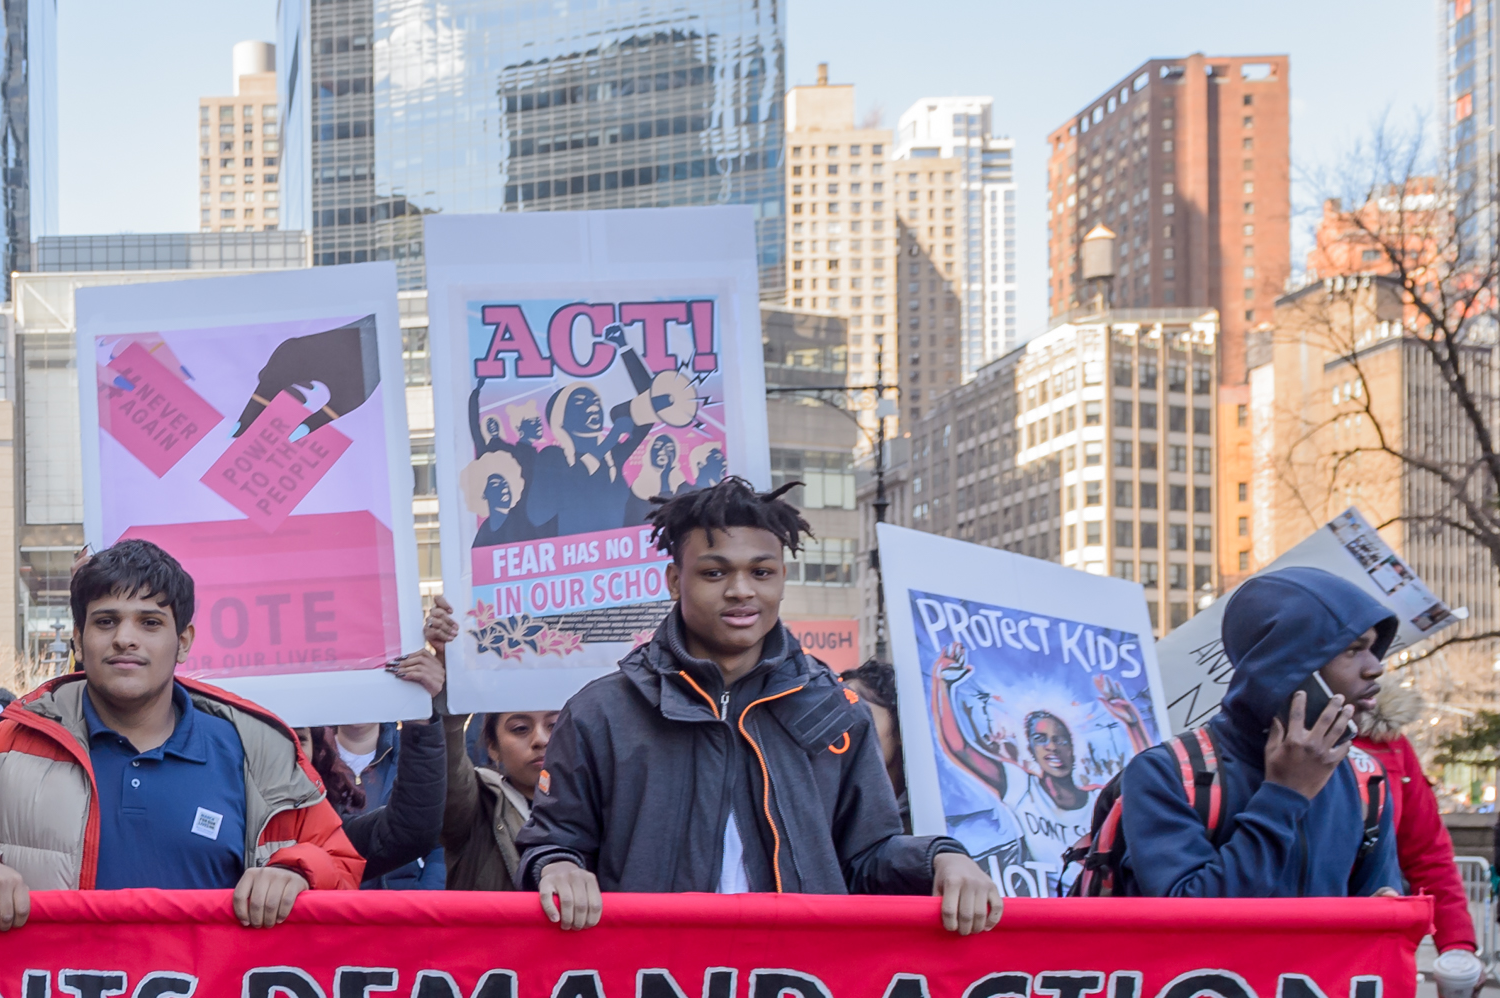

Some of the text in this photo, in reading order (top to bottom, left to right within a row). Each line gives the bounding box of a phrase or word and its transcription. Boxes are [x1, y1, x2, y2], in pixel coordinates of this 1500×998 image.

[474, 299, 718, 378] ACT!
[119, 399, 179, 451] AGAIN
[221, 416, 291, 486] POWER
[238, 470, 270, 498] TO
[255, 440, 331, 517] PEOPLE
[492, 542, 557, 579] FEAR
[562, 540, 600, 567] HAS
[605, 535, 634, 561] NO
[495, 566, 669, 617] IN OUR SCHO
[193, 590, 339, 650] OTE
[185, 647, 338, 672] OR OUR LIVES
[1058, 621, 1142, 679] KIDS
